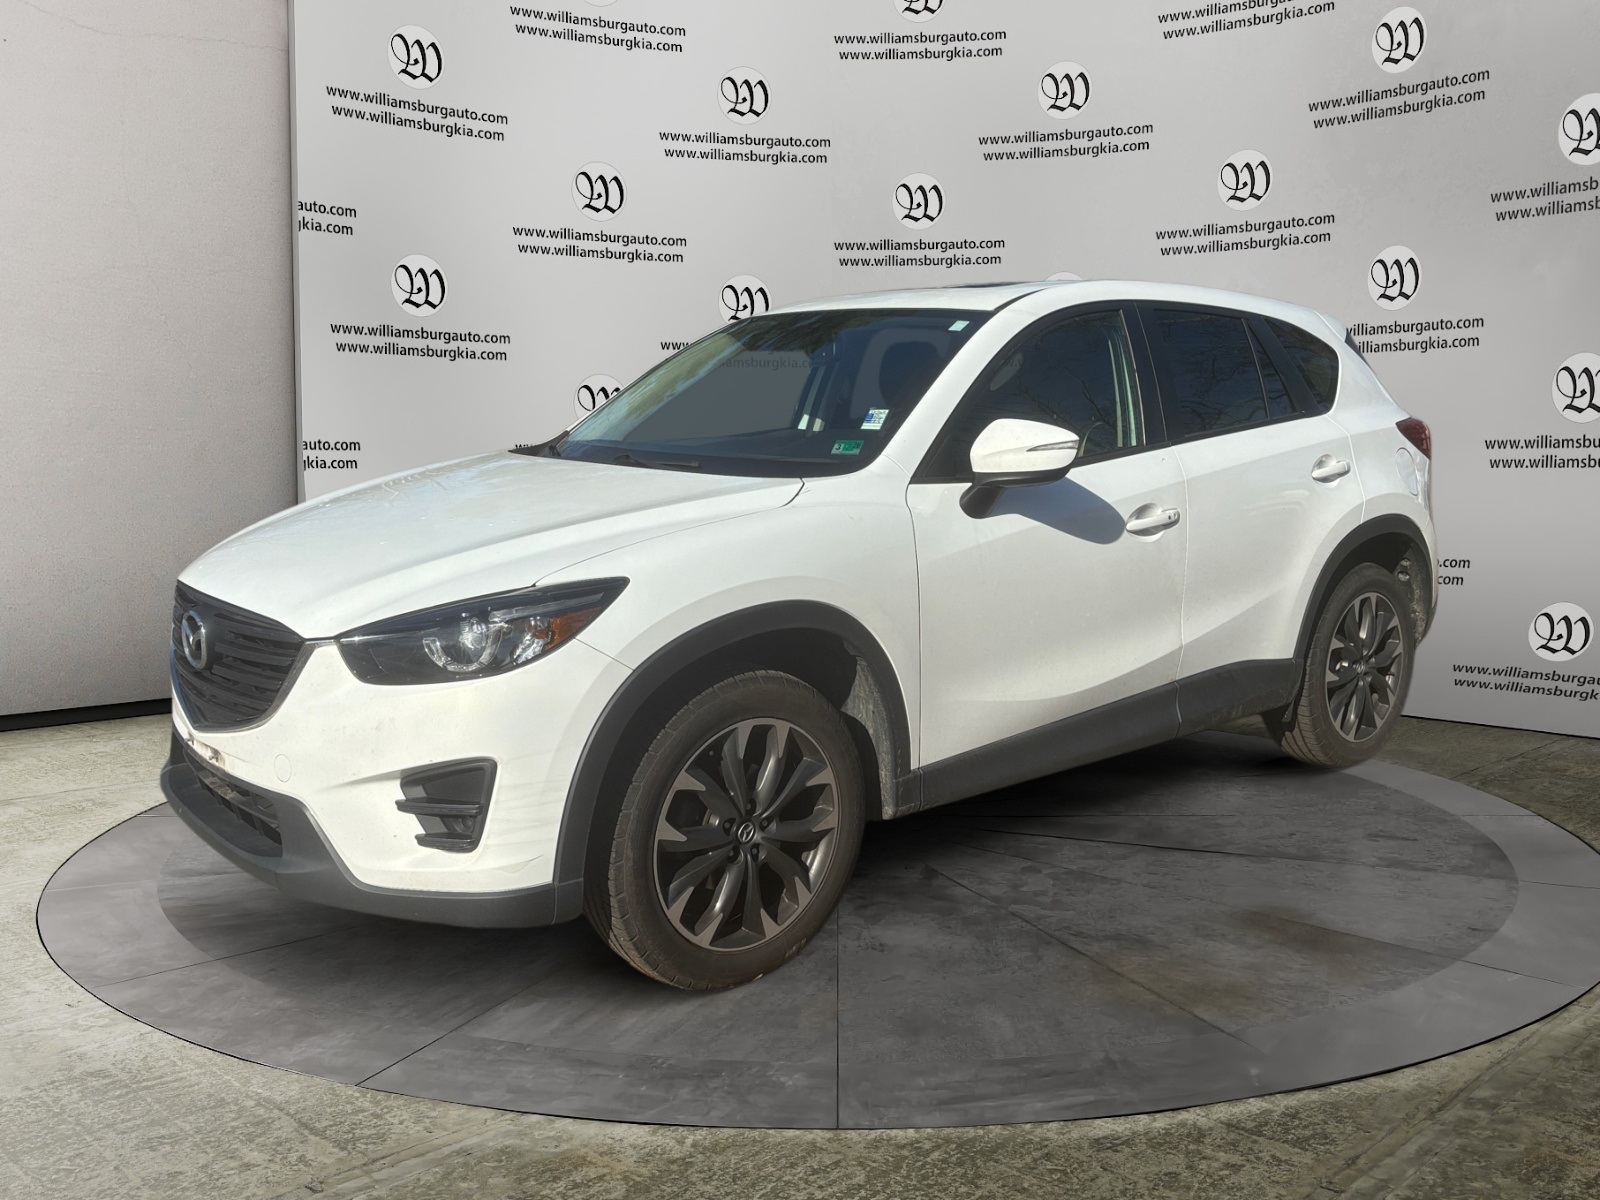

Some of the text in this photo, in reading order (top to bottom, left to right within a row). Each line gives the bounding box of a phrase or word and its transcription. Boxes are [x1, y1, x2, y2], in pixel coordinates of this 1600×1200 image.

[510, 6, 686, 37] www.williamsburgauto.com
[1162, 1, 1335, 40] www.williamsburgkia.com
[515, 24, 683, 53] www.williamsburgkia.com
[834, 31, 1007, 46] www.williamsburgauto.com
[838, 46, 1003, 62] www.williamsburgkia.com
[1308, 70, 1490, 112] www.williamsburgauto.com
[326, 86, 508, 125] www.williamsburgauto.com
[1313, 90, 1485, 129] www.williamsburgkia.com
[331, 105, 504, 142] www.williamsburgkia.com
[659, 132, 831, 150] www.williamsburgauto.com
[978, 124, 1154, 146] www.williamsburgauto.com
[664, 148, 828, 166] www.williamsburgkia.com
[983, 141, 1150, 161] www.williamsburgkia.com
[512, 226, 687, 247] www.williamsburgauto.com
[1155, 214, 1335, 240] www.williamsburgauto.com
[517, 244, 684, 264] www.williamsburgkia.com
[834, 238, 1005, 253] www.williamsburgauto.com
[1160, 232, 1331, 256] www.williamsburgkia.com
[838, 254, 1002, 269] www.williamsburgkia.com
[330, 323, 511, 344] www.williamsburgauto.com
[335, 342, 507, 362] www.williamsburgkia.com
